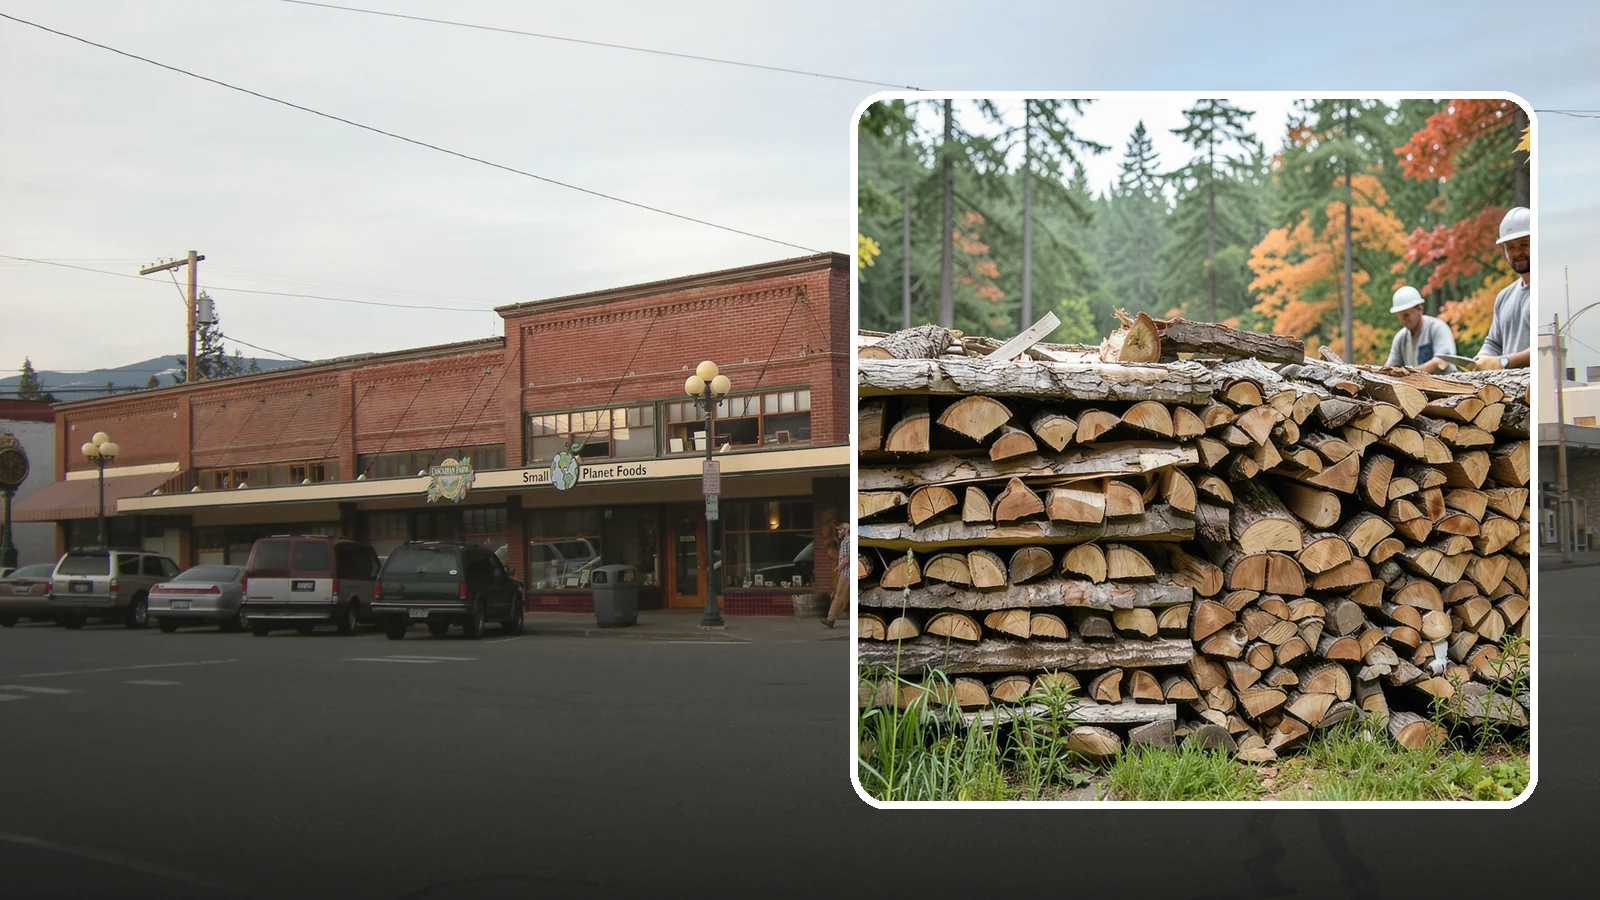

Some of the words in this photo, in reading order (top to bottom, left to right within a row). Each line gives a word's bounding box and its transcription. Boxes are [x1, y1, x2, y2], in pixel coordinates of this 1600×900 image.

[523, 471, 549, 483] Small
[583, 467, 614, 479] Planet
[617, 464, 647, 477] Foods
